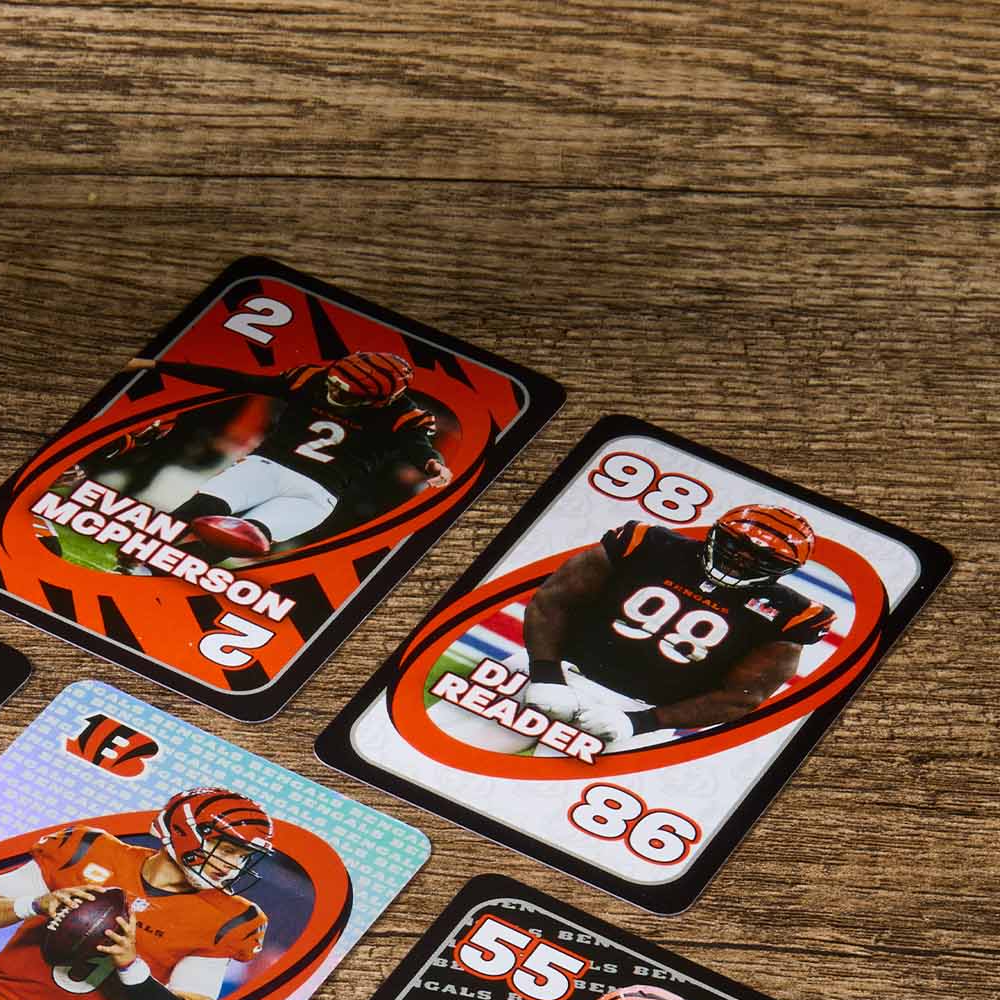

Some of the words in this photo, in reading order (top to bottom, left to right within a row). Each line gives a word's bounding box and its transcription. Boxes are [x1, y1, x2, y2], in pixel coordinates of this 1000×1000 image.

[222, 296, 293, 345] 2
[294, 420, 346, 463] 2
[70, 480, 189, 543] EVAN
[589, 452, 713, 523] 98
[30, 492, 296, 622] MCPHERSON
[199, 612, 277, 667] 2
[611, 585, 730, 664] 98
[471, 658, 530, 697] DJ
[430, 672, 604, 766] READER
